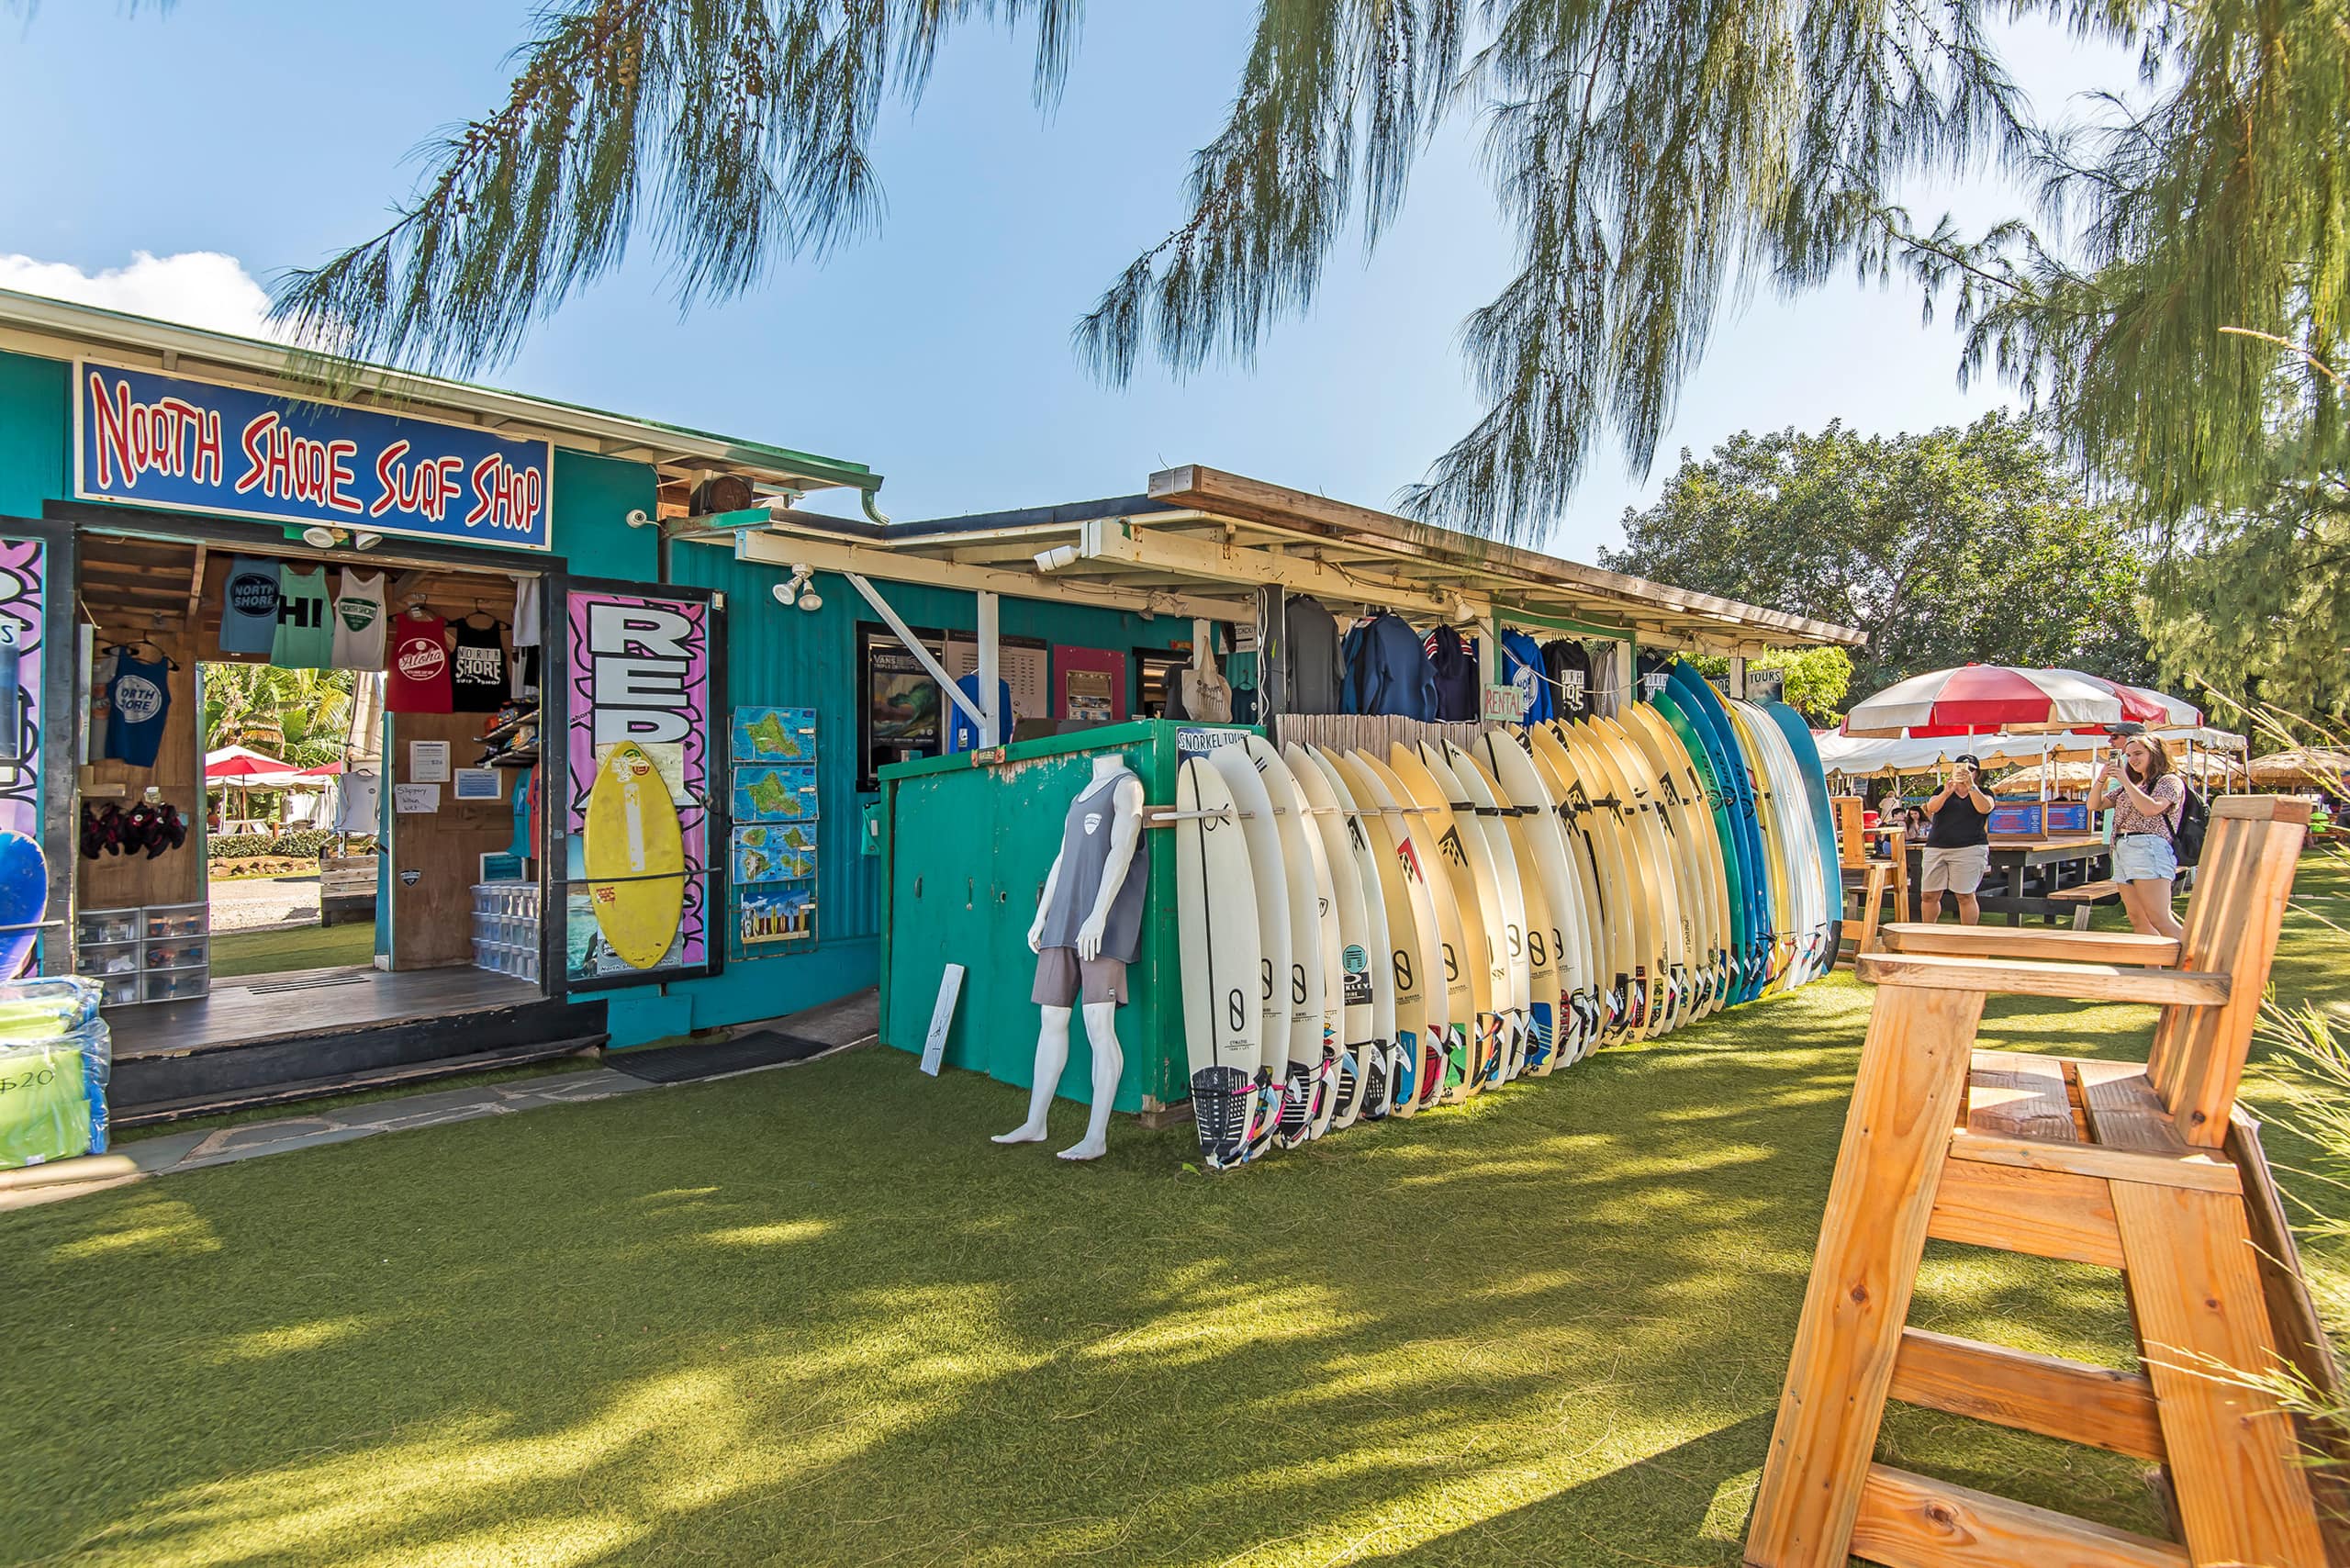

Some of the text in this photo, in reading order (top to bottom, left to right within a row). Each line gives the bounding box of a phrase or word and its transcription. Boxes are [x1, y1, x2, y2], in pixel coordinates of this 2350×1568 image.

[90, 372, 542, 532] NORTH SHORE SURF SHOP
[234, 585, 274, 595] NORTH
[234, 595, 274, 607] SHORE
[277, 595, 323, 628] HI
[400, 648, 442, 668] Aloha
[458, 648, 499, 660] NORTH
[455, 659, 501, 681] SHORE
[1749, 671, 1781, 684] TOURS
[120, 689, 155, 700] ORTH
[1484, 689, 1523, 717] RENTAL
[1179, 733, 1222, 751] SNORKEL
[1345, 983, 1369, 991] KLEY
